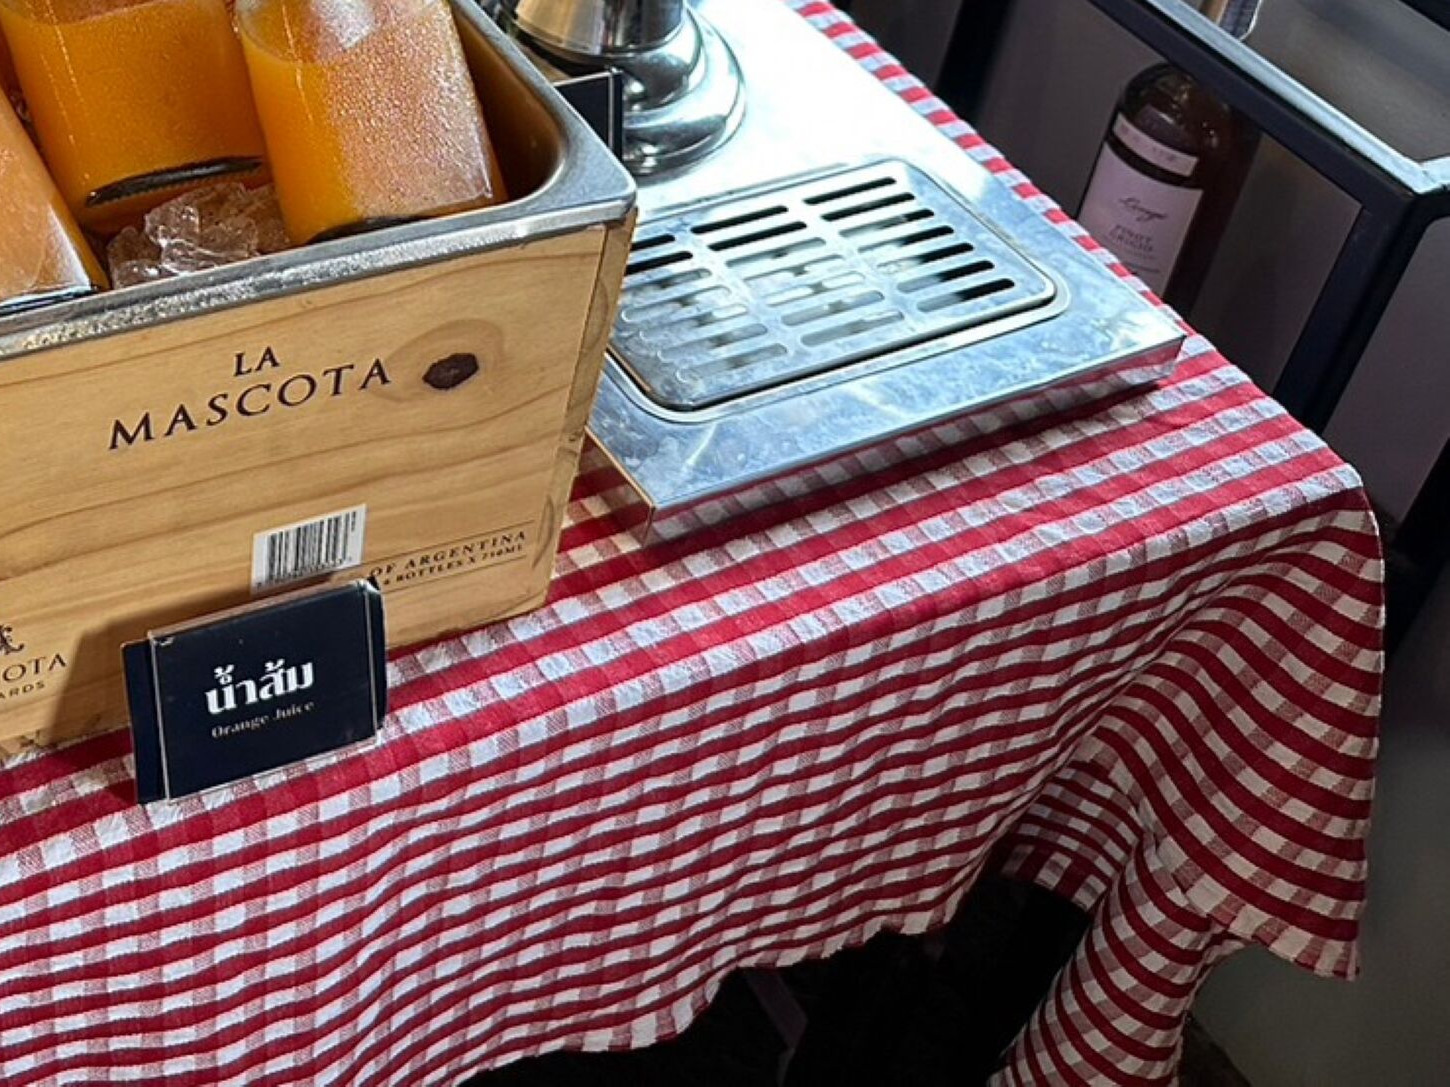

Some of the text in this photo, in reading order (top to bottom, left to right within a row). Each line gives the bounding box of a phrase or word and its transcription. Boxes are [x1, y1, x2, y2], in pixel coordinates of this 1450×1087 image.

[233, 346, 280, 376] LA
[109, 358, 390, 449] MASCOTA
[368, 559, 396, 579] OF
[405, 530, 527, 570] ARGENTINA
[395, 558, 464, 582] BOTTLES
[205, 658, 314, 715] น้ำส้ม
[211, 701, 315, 738] Orange Juice
